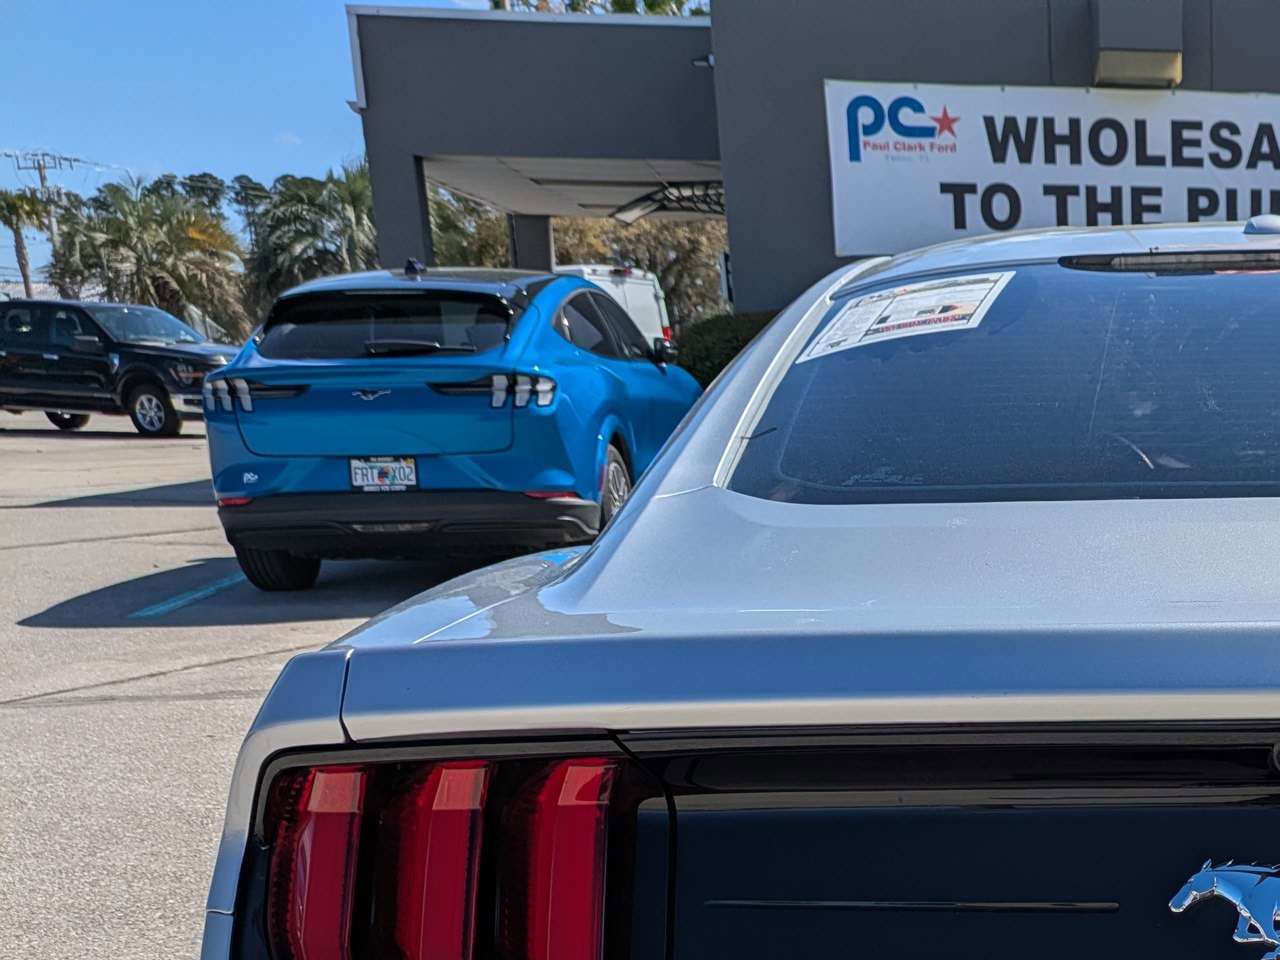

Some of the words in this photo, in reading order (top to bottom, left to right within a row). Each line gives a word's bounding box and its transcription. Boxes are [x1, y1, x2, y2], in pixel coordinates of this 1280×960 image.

[863, 140, 889, 151] Paul
[894, 141, 925, 152] Clark
[929, 142, 957, 153] Ford
[940, 182, 1022, 231] TO
[1043, 184, 1163, 227] THE
